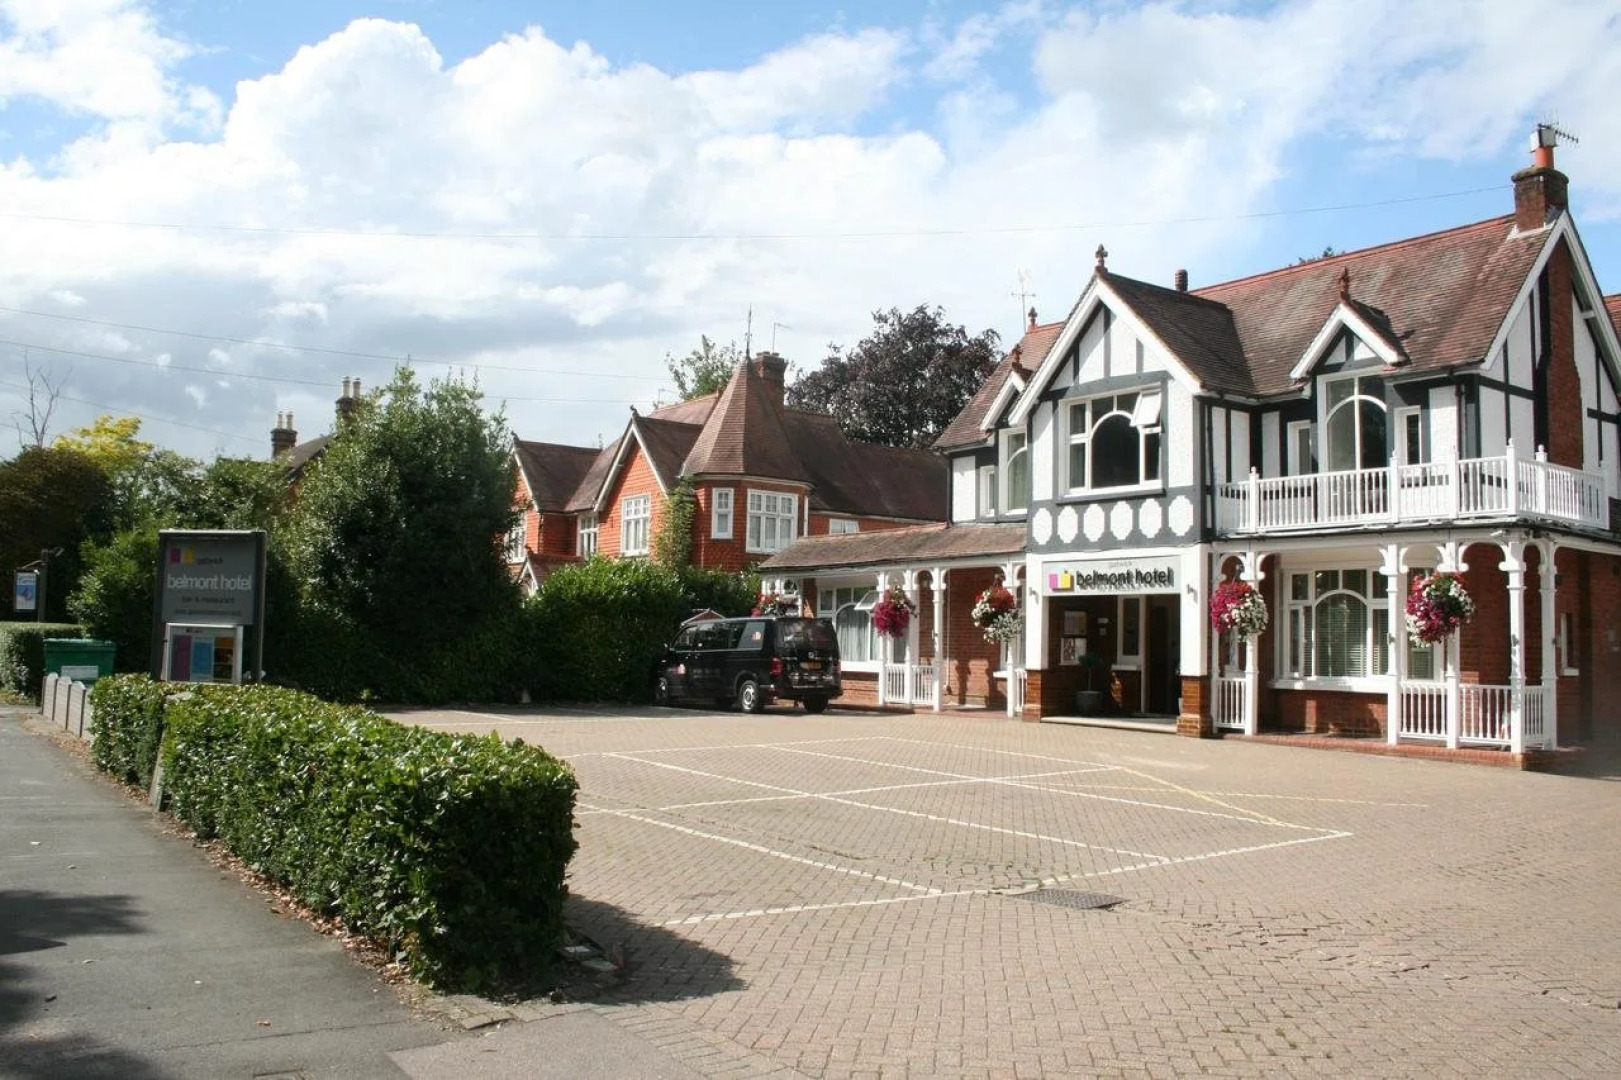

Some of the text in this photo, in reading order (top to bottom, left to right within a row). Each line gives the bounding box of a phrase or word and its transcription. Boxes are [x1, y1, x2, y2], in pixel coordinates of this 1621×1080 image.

[167, 573, 253, 590] belmont hotel
[1076, 567, 1173, 587] belmont hotel
